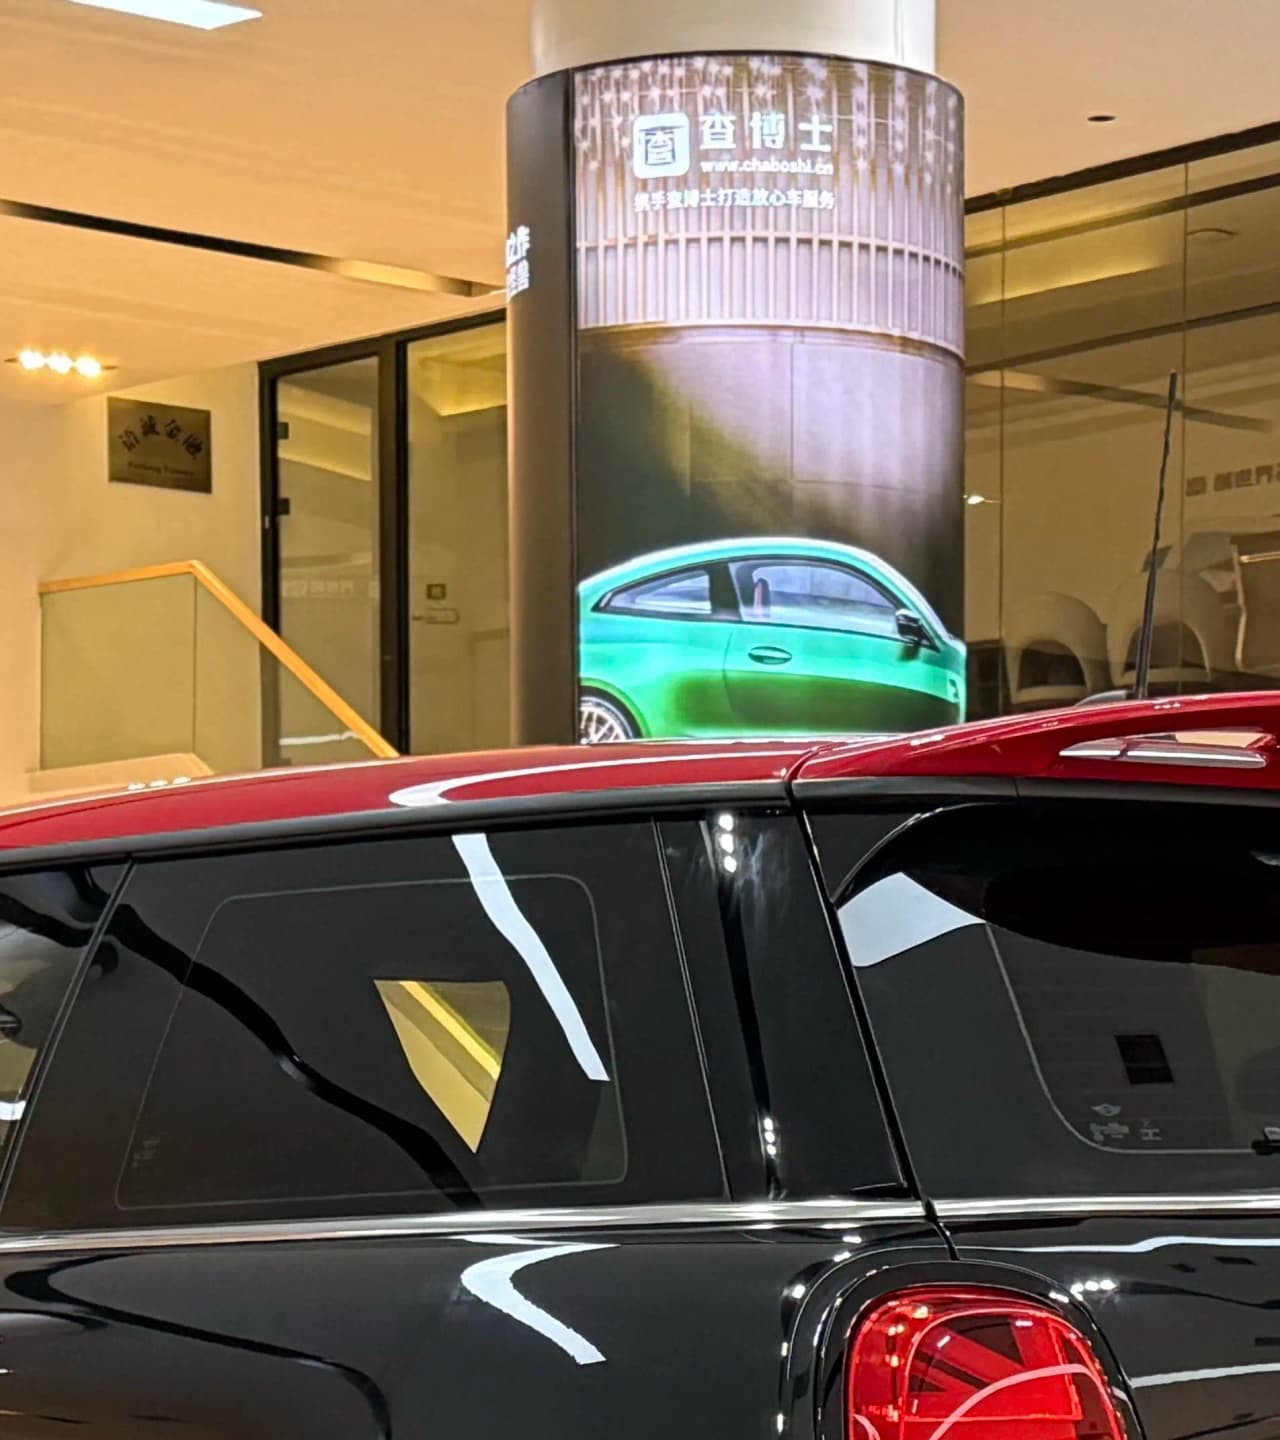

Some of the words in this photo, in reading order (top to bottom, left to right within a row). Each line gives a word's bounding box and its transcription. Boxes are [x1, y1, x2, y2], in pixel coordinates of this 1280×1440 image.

[699, 111, 833, 152] 查博士
[700, 159, 834, 175] www.chaboshi.cn
